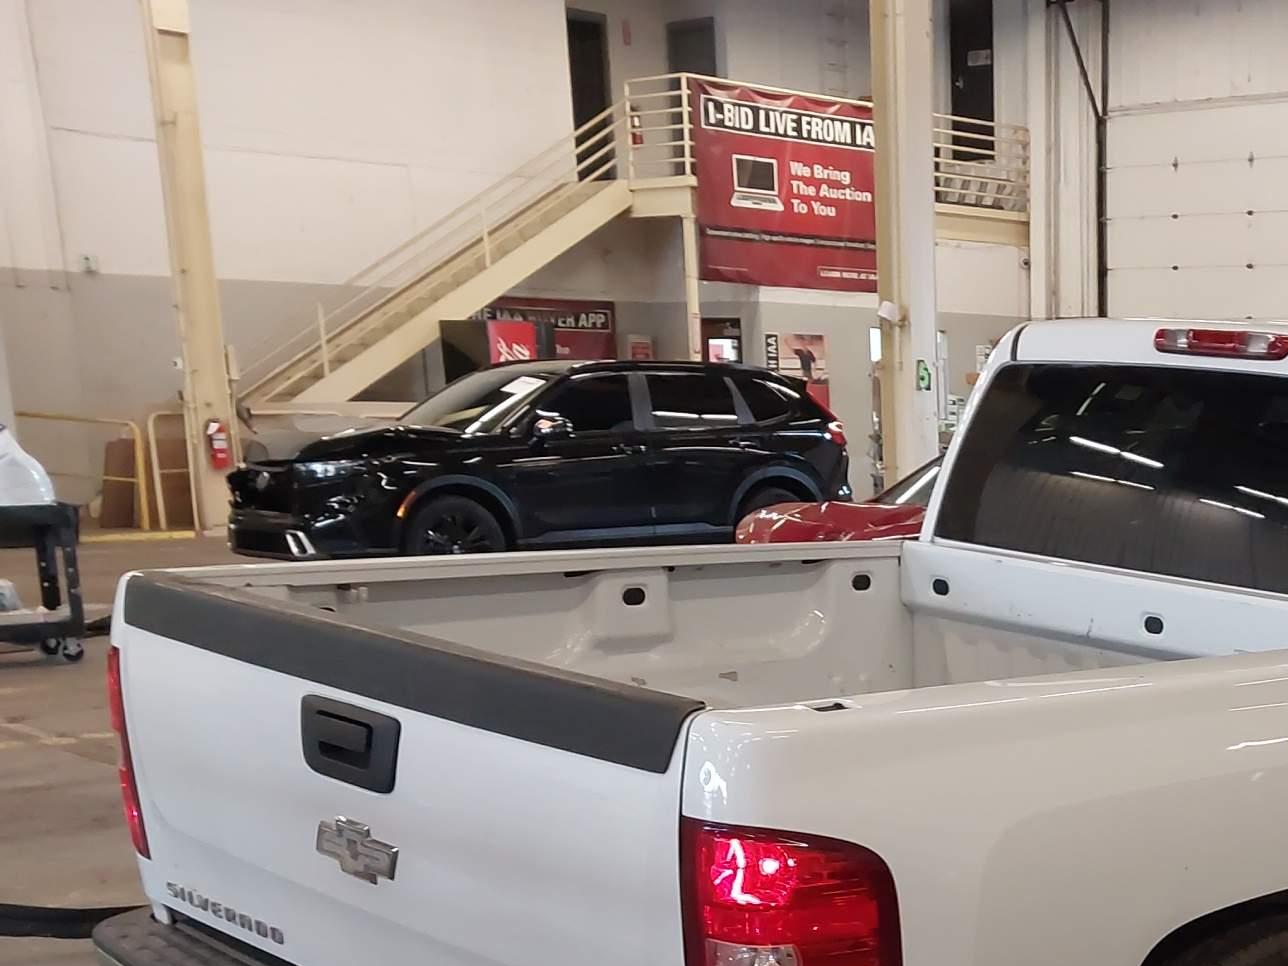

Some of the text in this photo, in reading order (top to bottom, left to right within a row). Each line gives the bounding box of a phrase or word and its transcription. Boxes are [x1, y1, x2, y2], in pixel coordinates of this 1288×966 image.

[707, 101, 875, 147] I-BID LIVE FROM IA
[789, 160, 850, 185] We Bring
[790, 180, 872, 202] The Auction
[791, 199, 836, 217] To You
[577, 312, 606, 328] APP
[166, 881, 285, 945] SILVERADO
